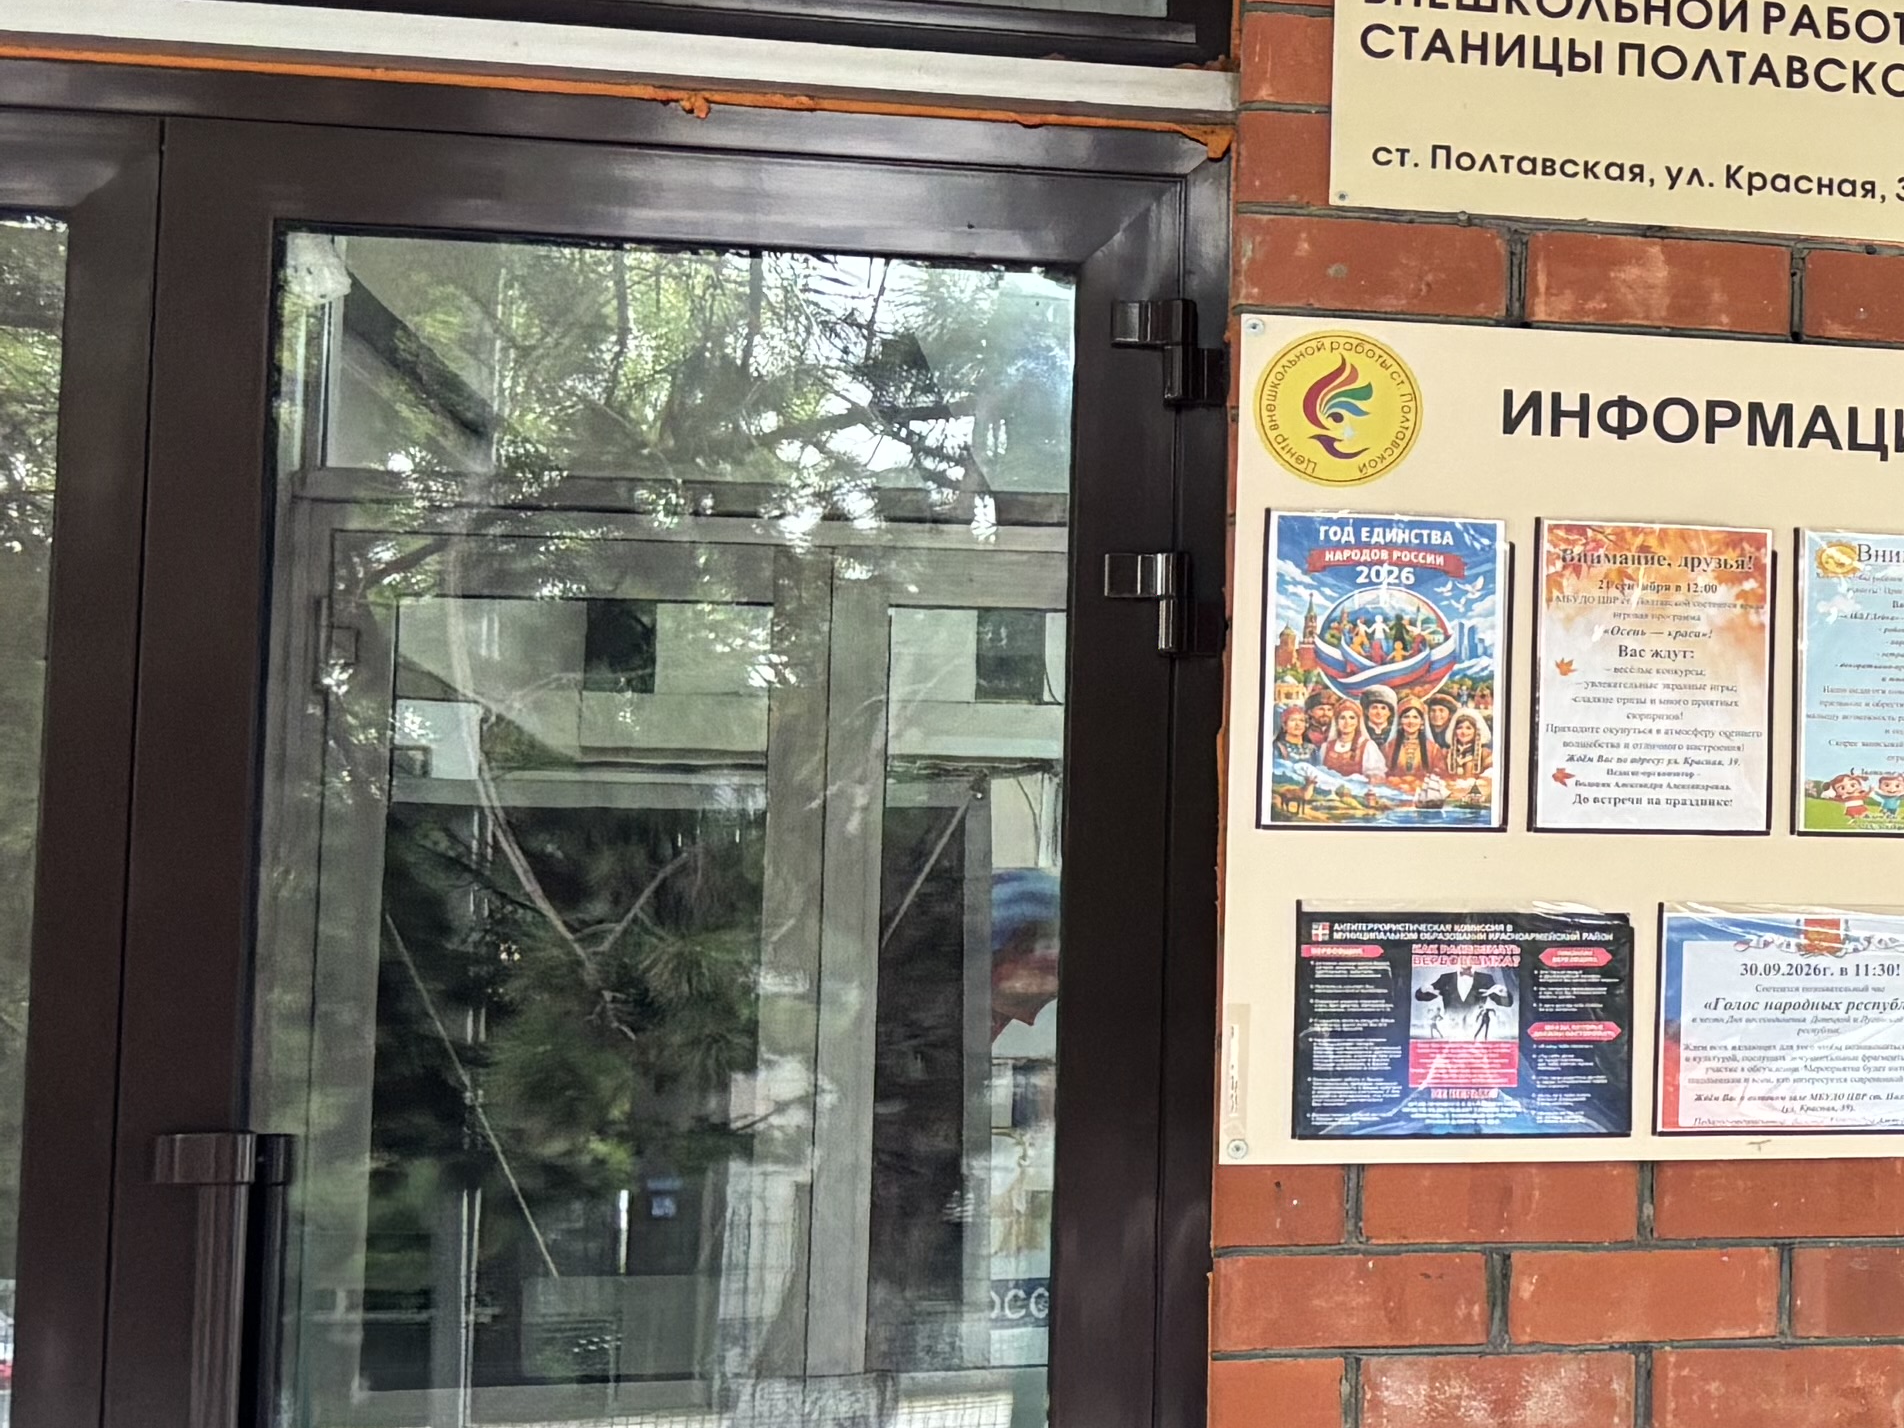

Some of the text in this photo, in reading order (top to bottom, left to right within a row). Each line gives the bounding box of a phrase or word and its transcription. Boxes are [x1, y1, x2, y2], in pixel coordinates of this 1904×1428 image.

[1359, 23, 1602, 77] СТАНИЦЫ
[1372, 145, 1419, 168] ст.
[1430, 145, 1654, 185] Полтавская,
[1665, 160, 1714, 189] ул.
[1725, 164, 1886, 203] Красная,
[1330, 341, 1393, 371] работы
[1265, 340, 1326, 430] внешкольной
[1358, 392, 1414, 476] Полтавской
[1274, 433, 1318, 475] Центр
[1319, 525, 1454, 546] ГОД ЕДИНСТВА
[1325, 550, 1444, 566] НАРОДОВ РОССИИ
[1561, 548, 1753, 572] Внимание, друзья!
[1355, 566, 1415, 585] 2026
[1687, 583, 1718, 594] 12:00
[1619, 645, 1695, 662] Вас ждут:
[1740, 963, 1834, 977] 30.09.2026г.
[1854, 964, 1901, 977] 11:30!
[1704, 997, 1760, 1011] «Голос
[1764, 998, 1840, 1014] народных
